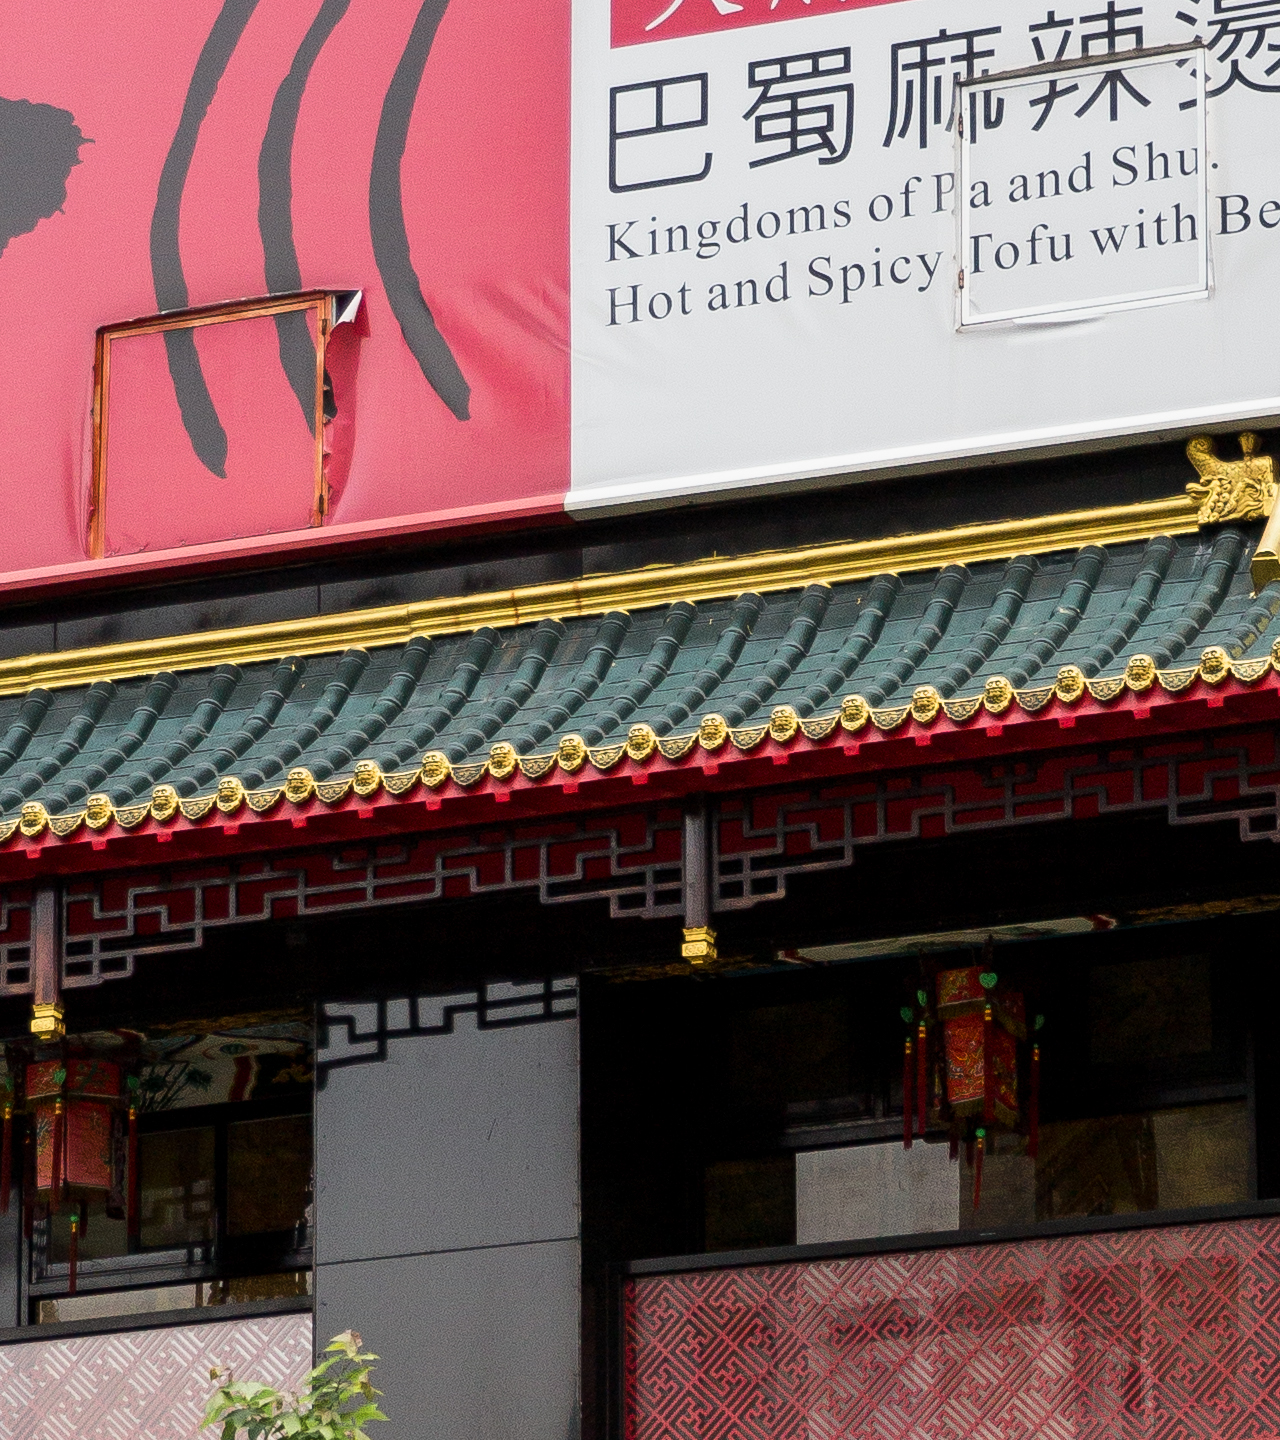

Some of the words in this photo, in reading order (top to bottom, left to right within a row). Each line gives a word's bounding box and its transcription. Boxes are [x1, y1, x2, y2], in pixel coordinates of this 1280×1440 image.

[605, 196, 852, 263] Kingdoms
[868, 177, 923, 218] of
[933, 172, 994, 212] Pa
[1008, 153, 1096, 200] and
[606, 278, 694, 327] Hot
[706, 265, 800, 314] and
[807, 248, 945, 312] Spicy
[968, 222, 1075, 276] Tofu
[1090, 204, 1199, 254] with
